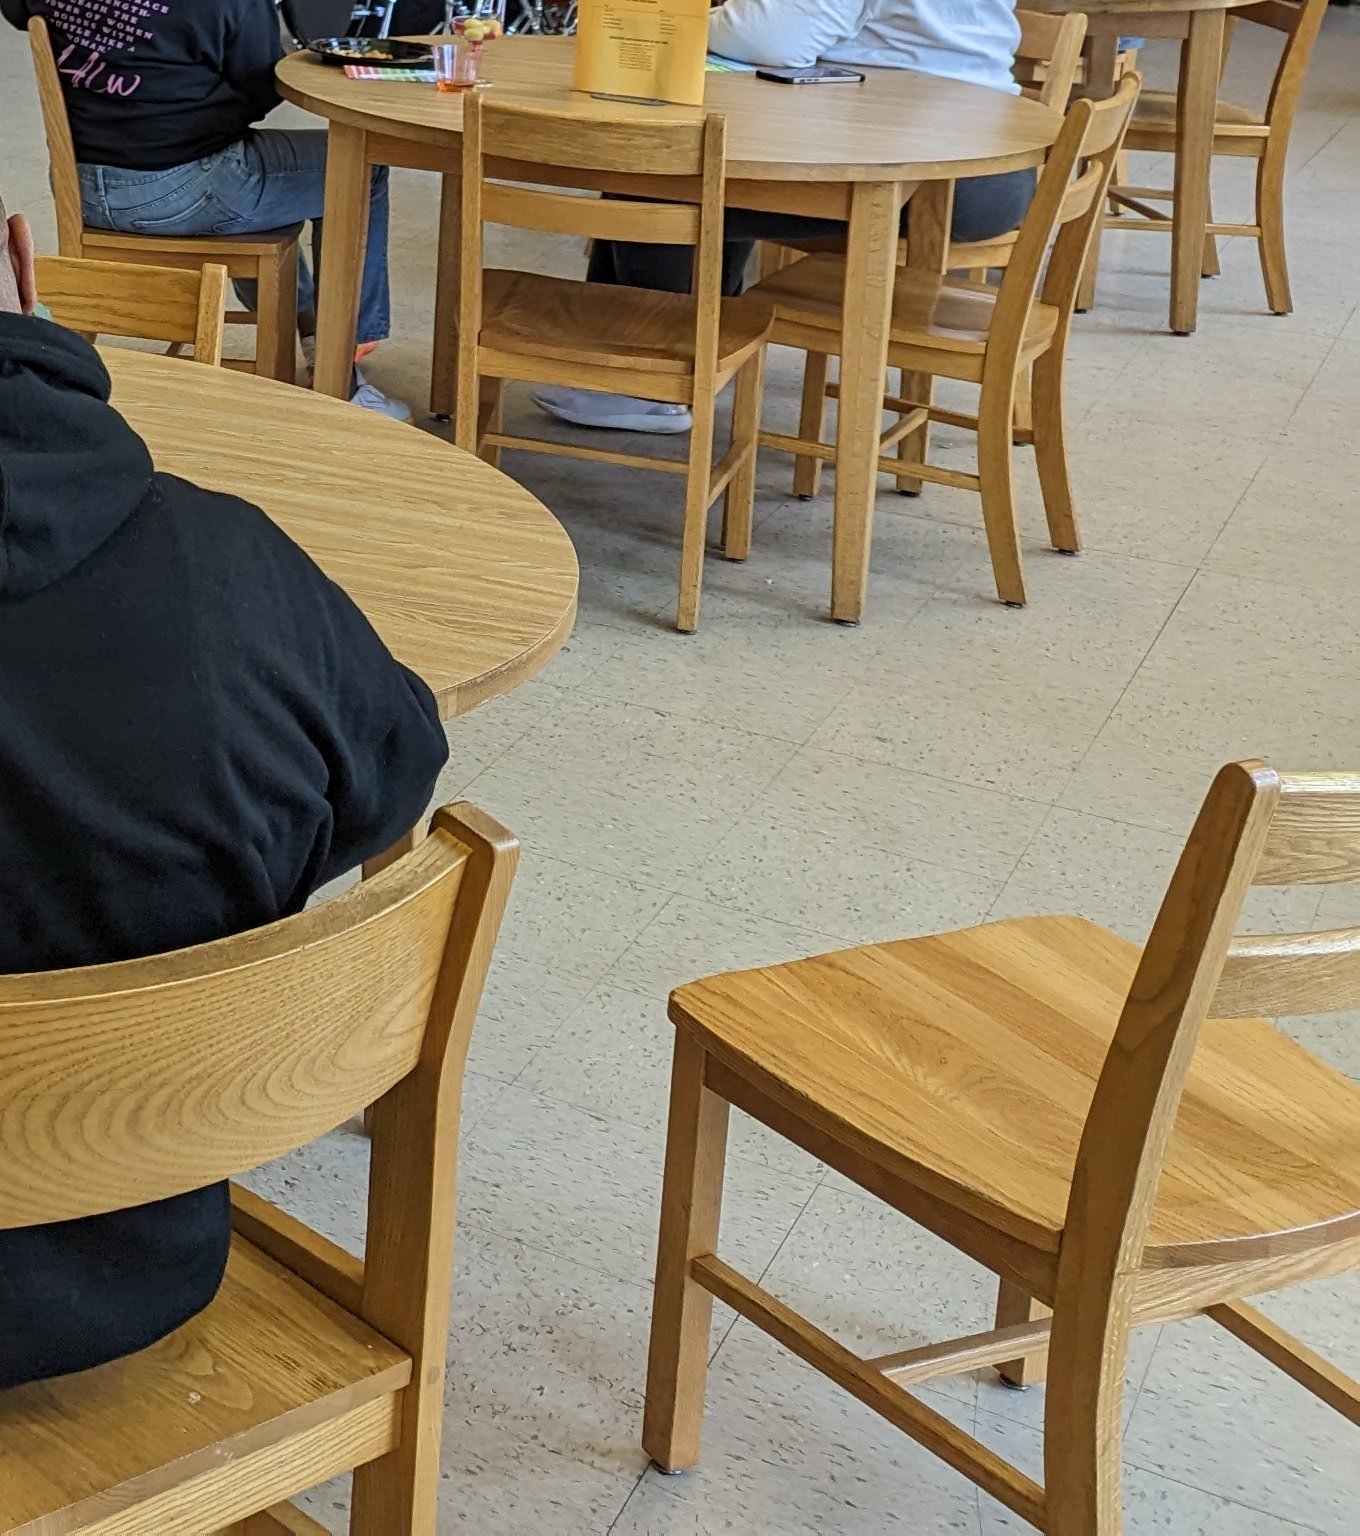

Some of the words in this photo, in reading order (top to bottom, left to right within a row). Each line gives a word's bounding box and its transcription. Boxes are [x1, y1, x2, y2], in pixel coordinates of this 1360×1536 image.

[85, 10, 102, 22] OF
[106, 18, 154, 40] WOMEN
[114, 10, 138, 24] THE
[50, 18, 92, 38] USTLE
[95, 34, 124, 49] LIKE
[102, 26, 135, 42] WITH
